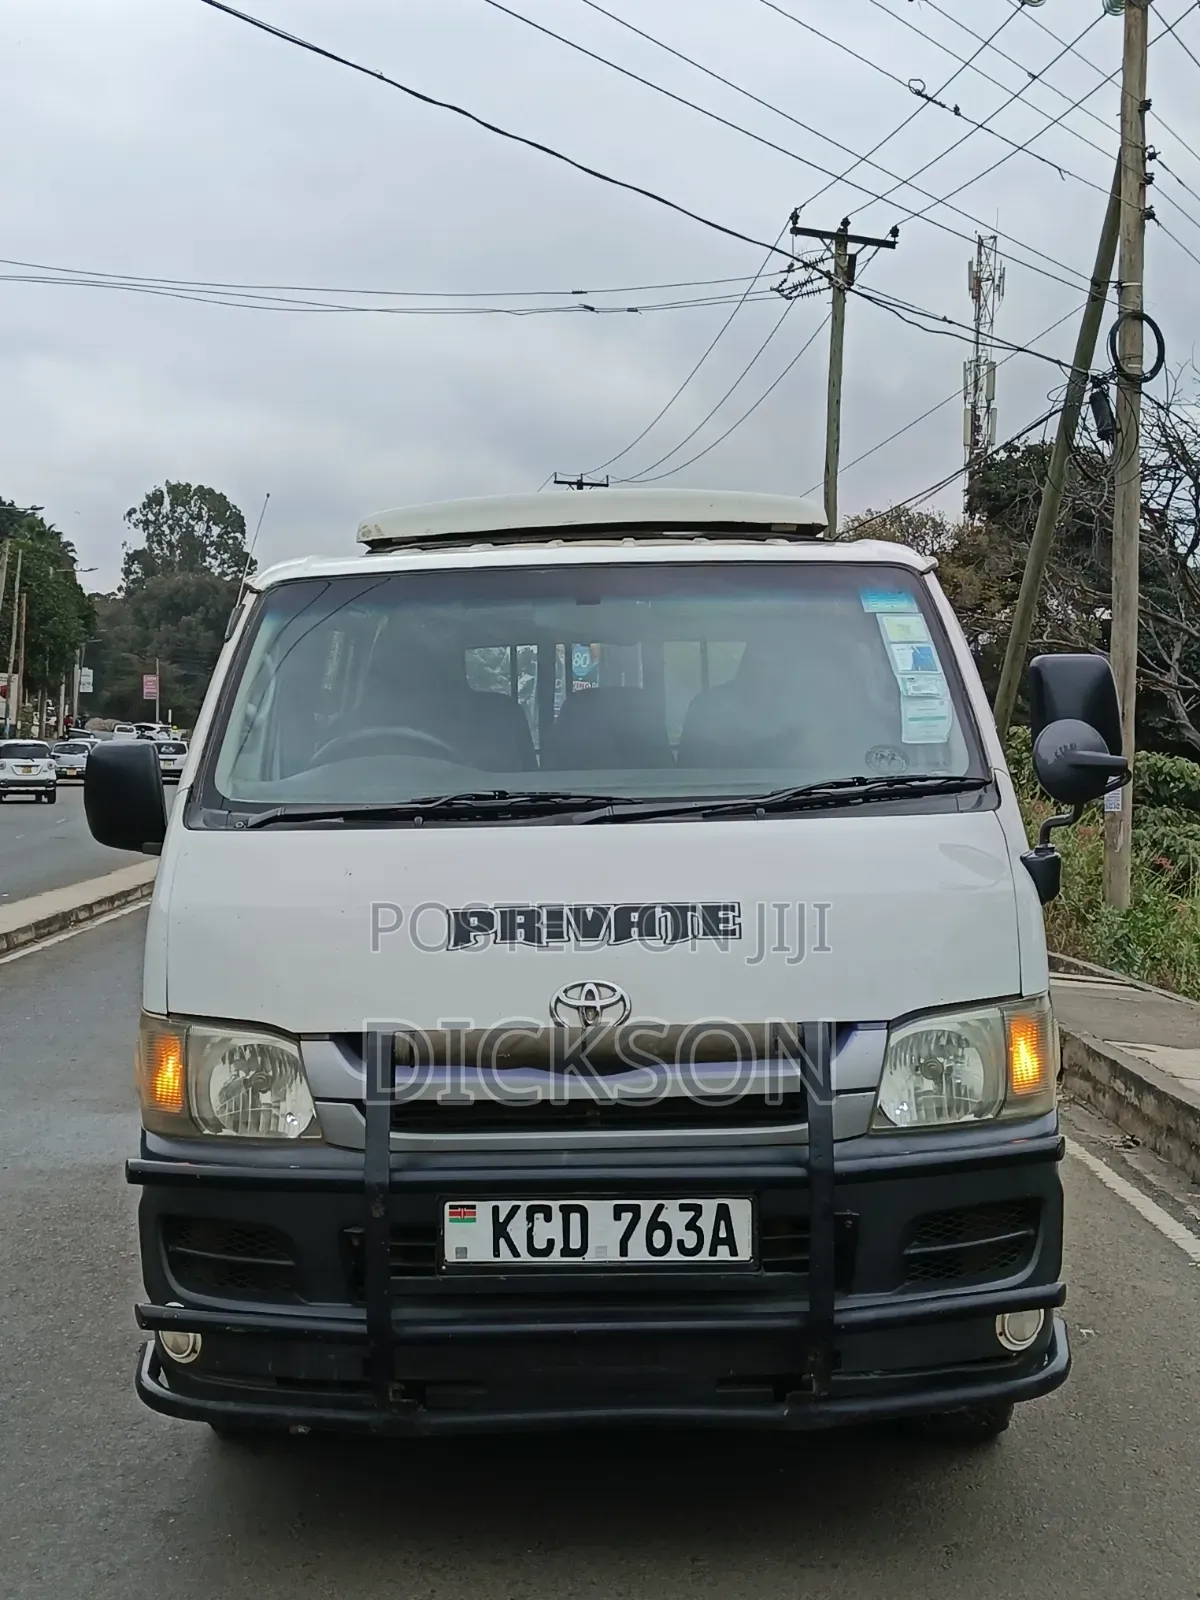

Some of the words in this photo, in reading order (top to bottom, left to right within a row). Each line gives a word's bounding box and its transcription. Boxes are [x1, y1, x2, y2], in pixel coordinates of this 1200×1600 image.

[446, 901, 743, 952] PRIVATE
[492, 1203, 589, 1258] KCD
[613, 1203, 739, 1258] 763A
